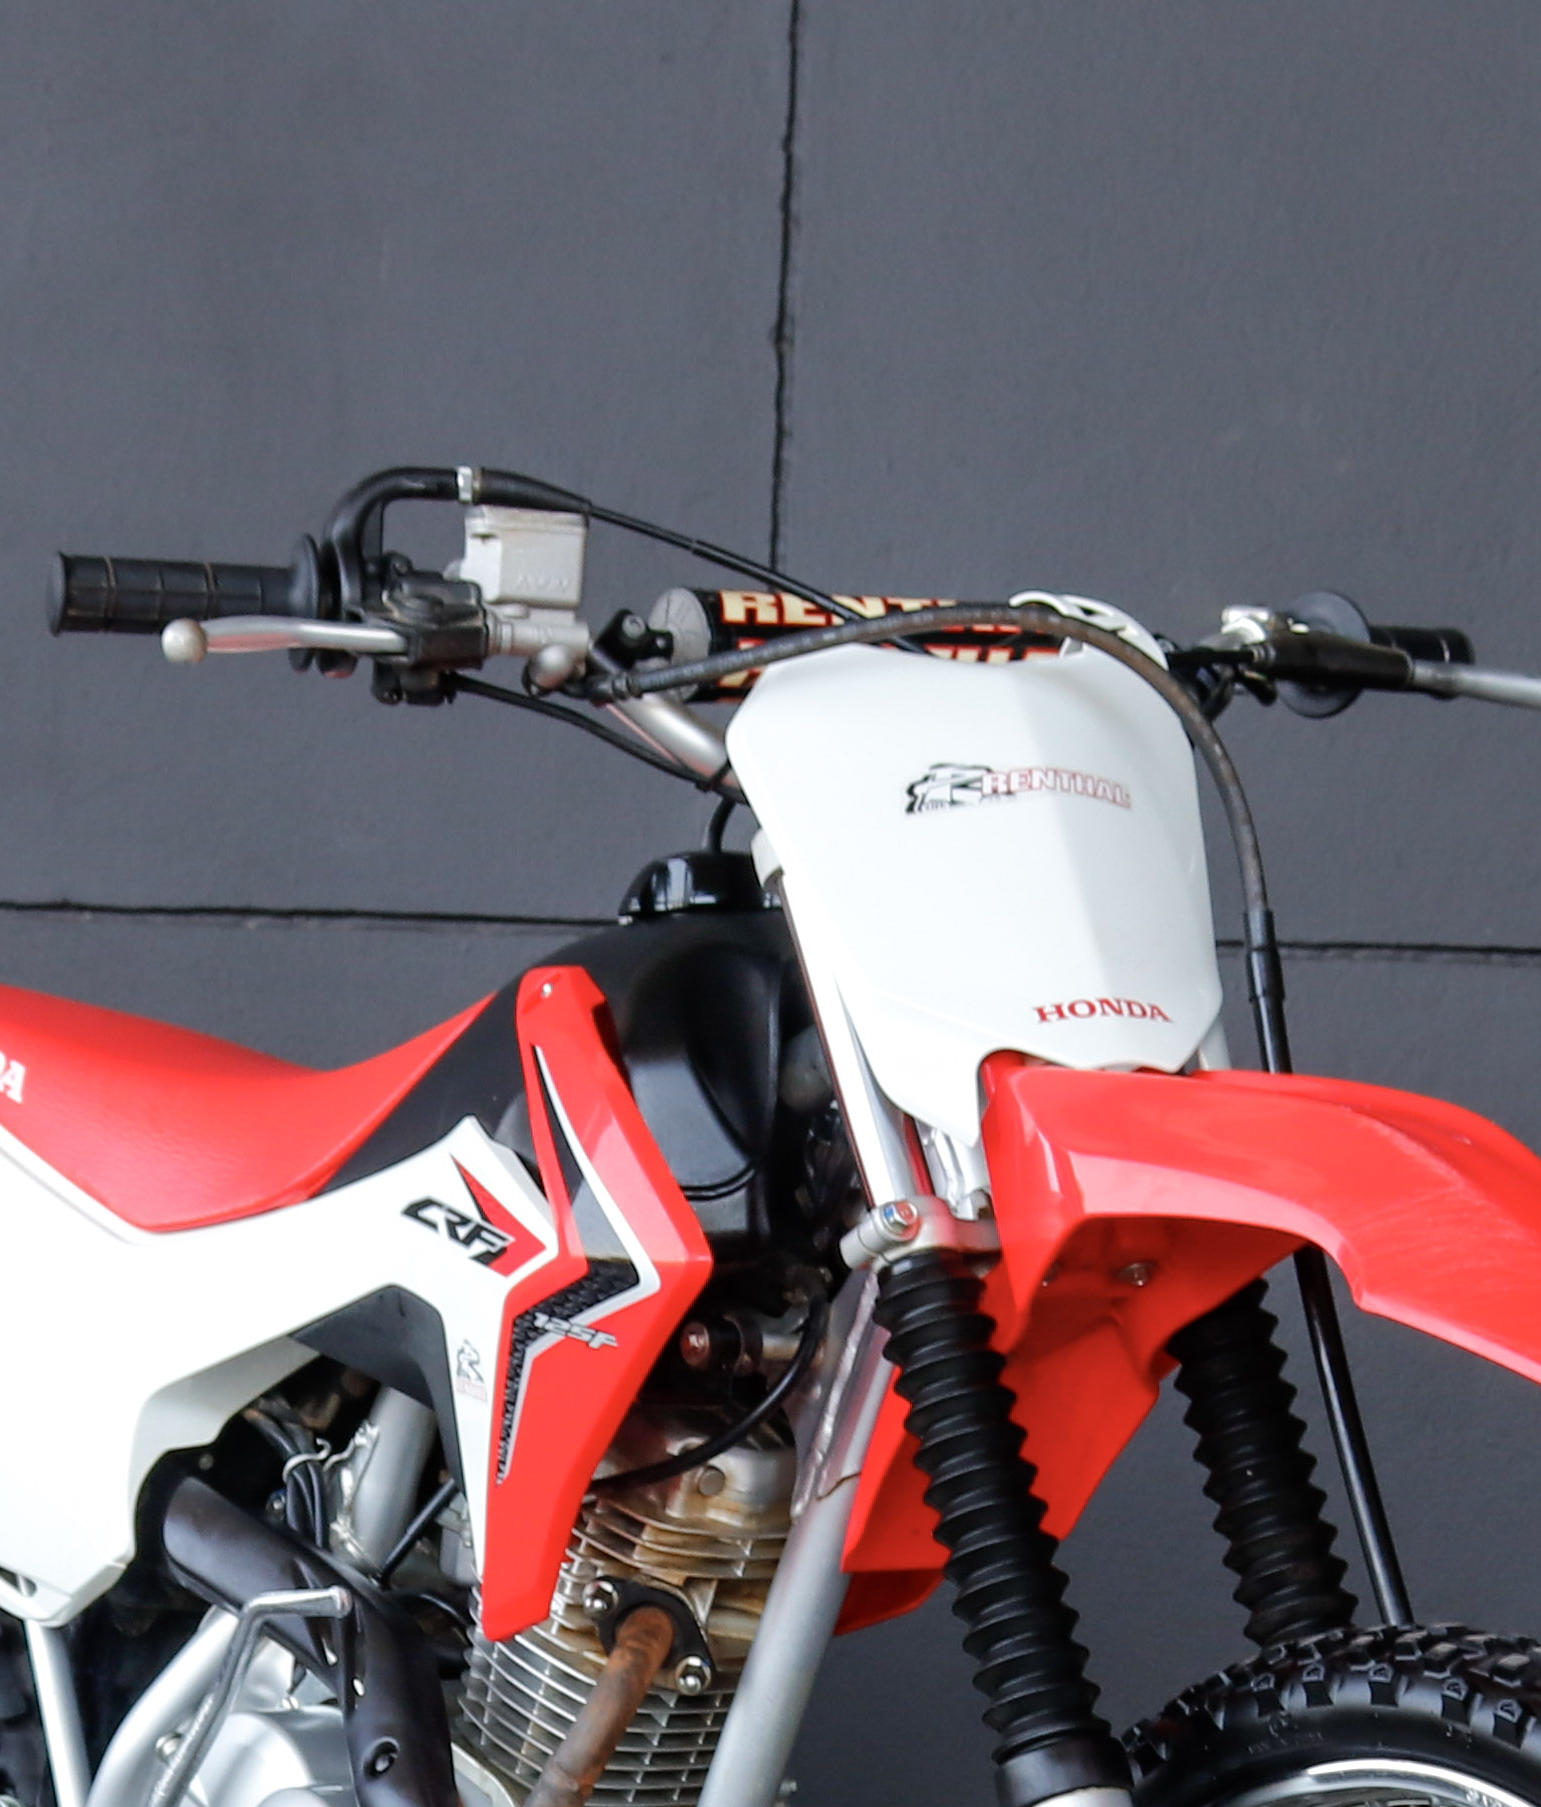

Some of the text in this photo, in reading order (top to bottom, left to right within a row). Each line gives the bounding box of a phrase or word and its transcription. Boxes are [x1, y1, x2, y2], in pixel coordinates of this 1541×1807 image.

[982, 768, 1131, 809] RENTHAL
[1032, 996, 1174, 1025] HONDA
[400, 1195, 516, 1267] CRF
